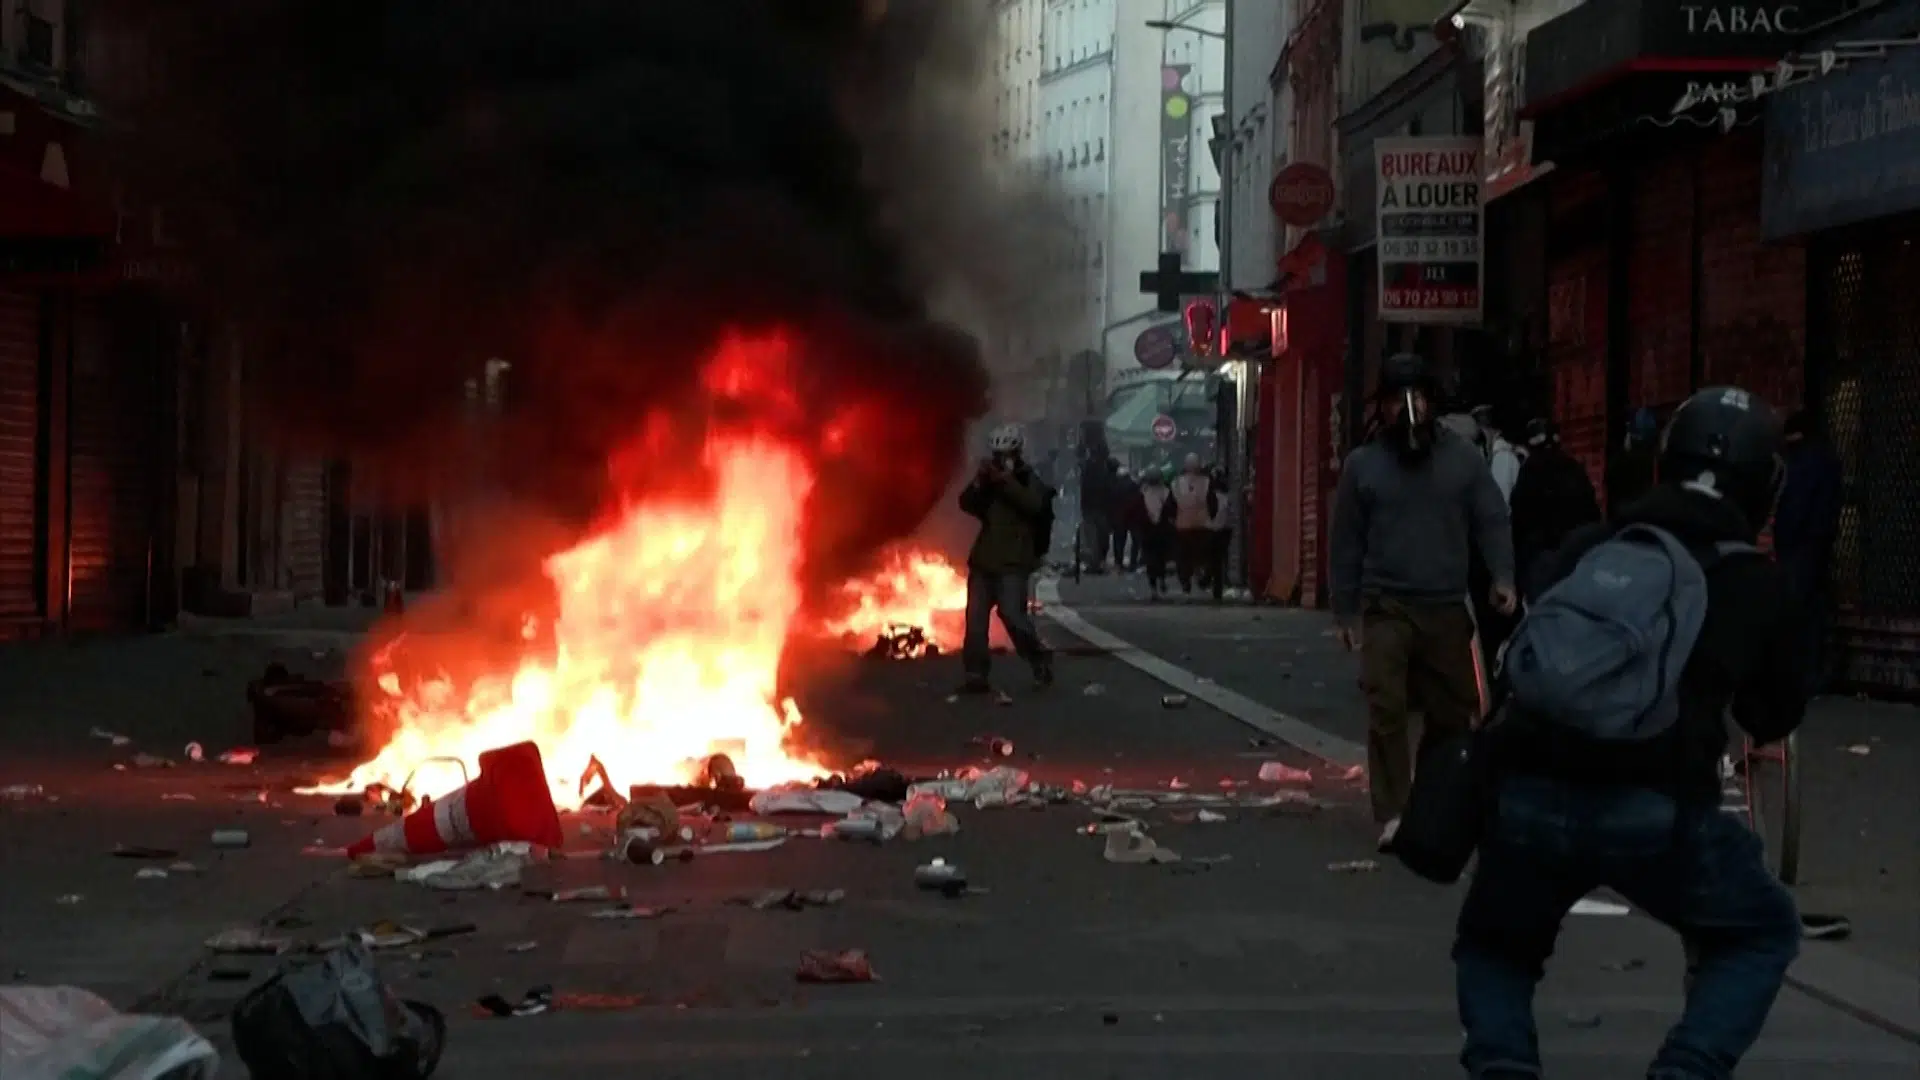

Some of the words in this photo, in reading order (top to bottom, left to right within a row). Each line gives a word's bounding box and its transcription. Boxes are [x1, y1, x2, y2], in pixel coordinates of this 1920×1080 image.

[1680, 5, 1799, 33] TABAC
[1686, 81, 1737, 103] BAR
[1381, 151, 1478, 176] BUREAUX
[1405, 182, 1478, 207] LOUER
